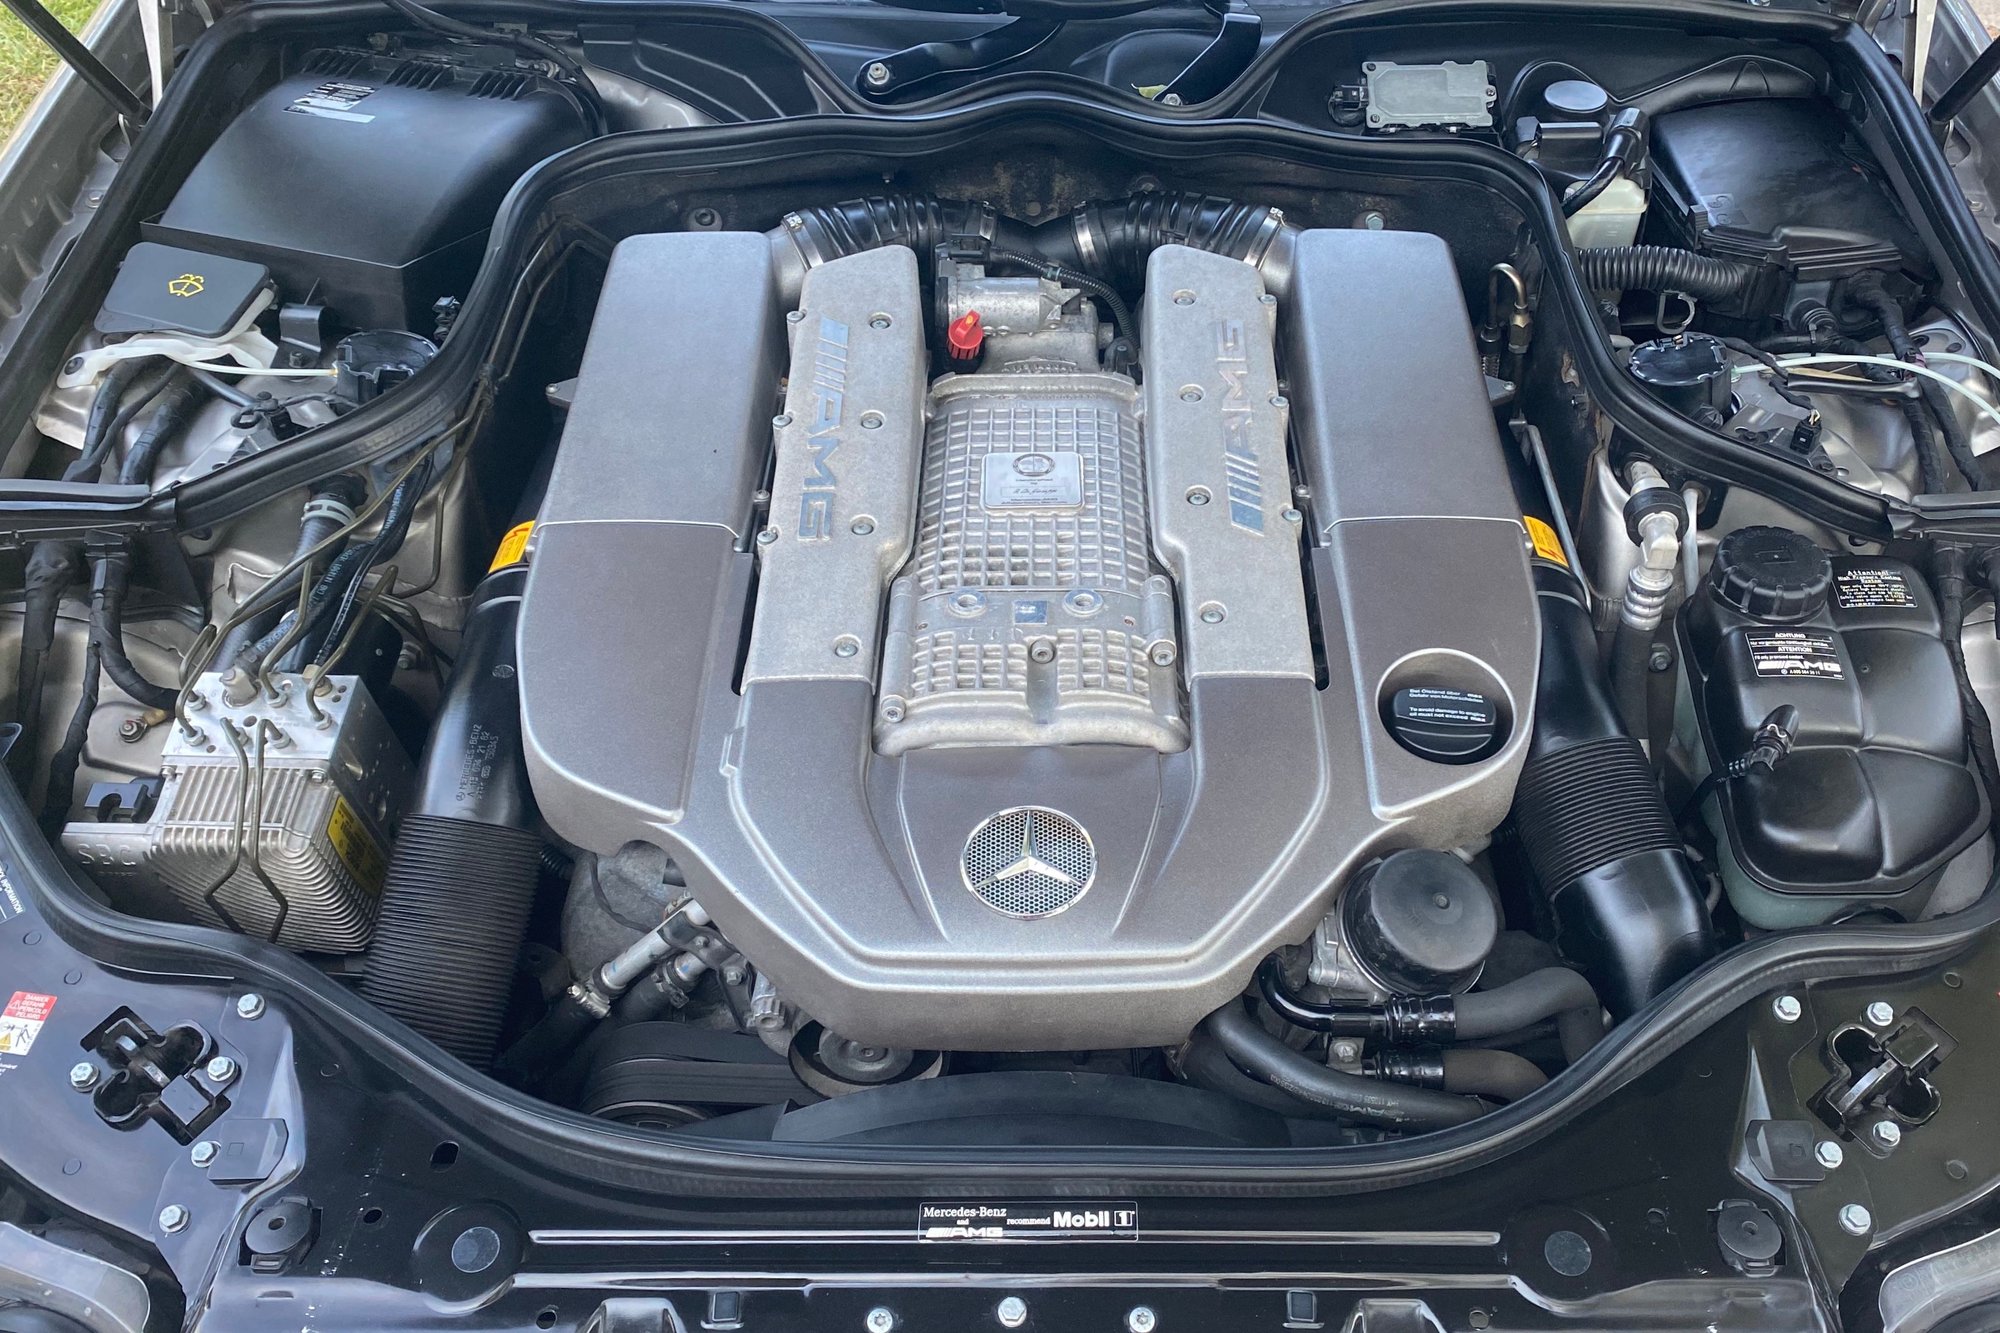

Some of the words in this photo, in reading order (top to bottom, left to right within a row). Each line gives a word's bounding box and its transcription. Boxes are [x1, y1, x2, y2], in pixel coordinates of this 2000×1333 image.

[797, 390, 844, 542] AMG
[1783, 660, 1842, 672] AMG
[459, 724, 482, 790] MERCEDES-BENZ
[78, 844, 136, 866] SBC
[0, 878, 24, 914] INFORMATION
[924, 1207, 1006, 1218] Mercedes-Benz
[1006, 1217, 1051, 1225] recommend
[1053, 1210, 1110, 1228] Mobil
[950, 1227, 1004, 1238] AMG
